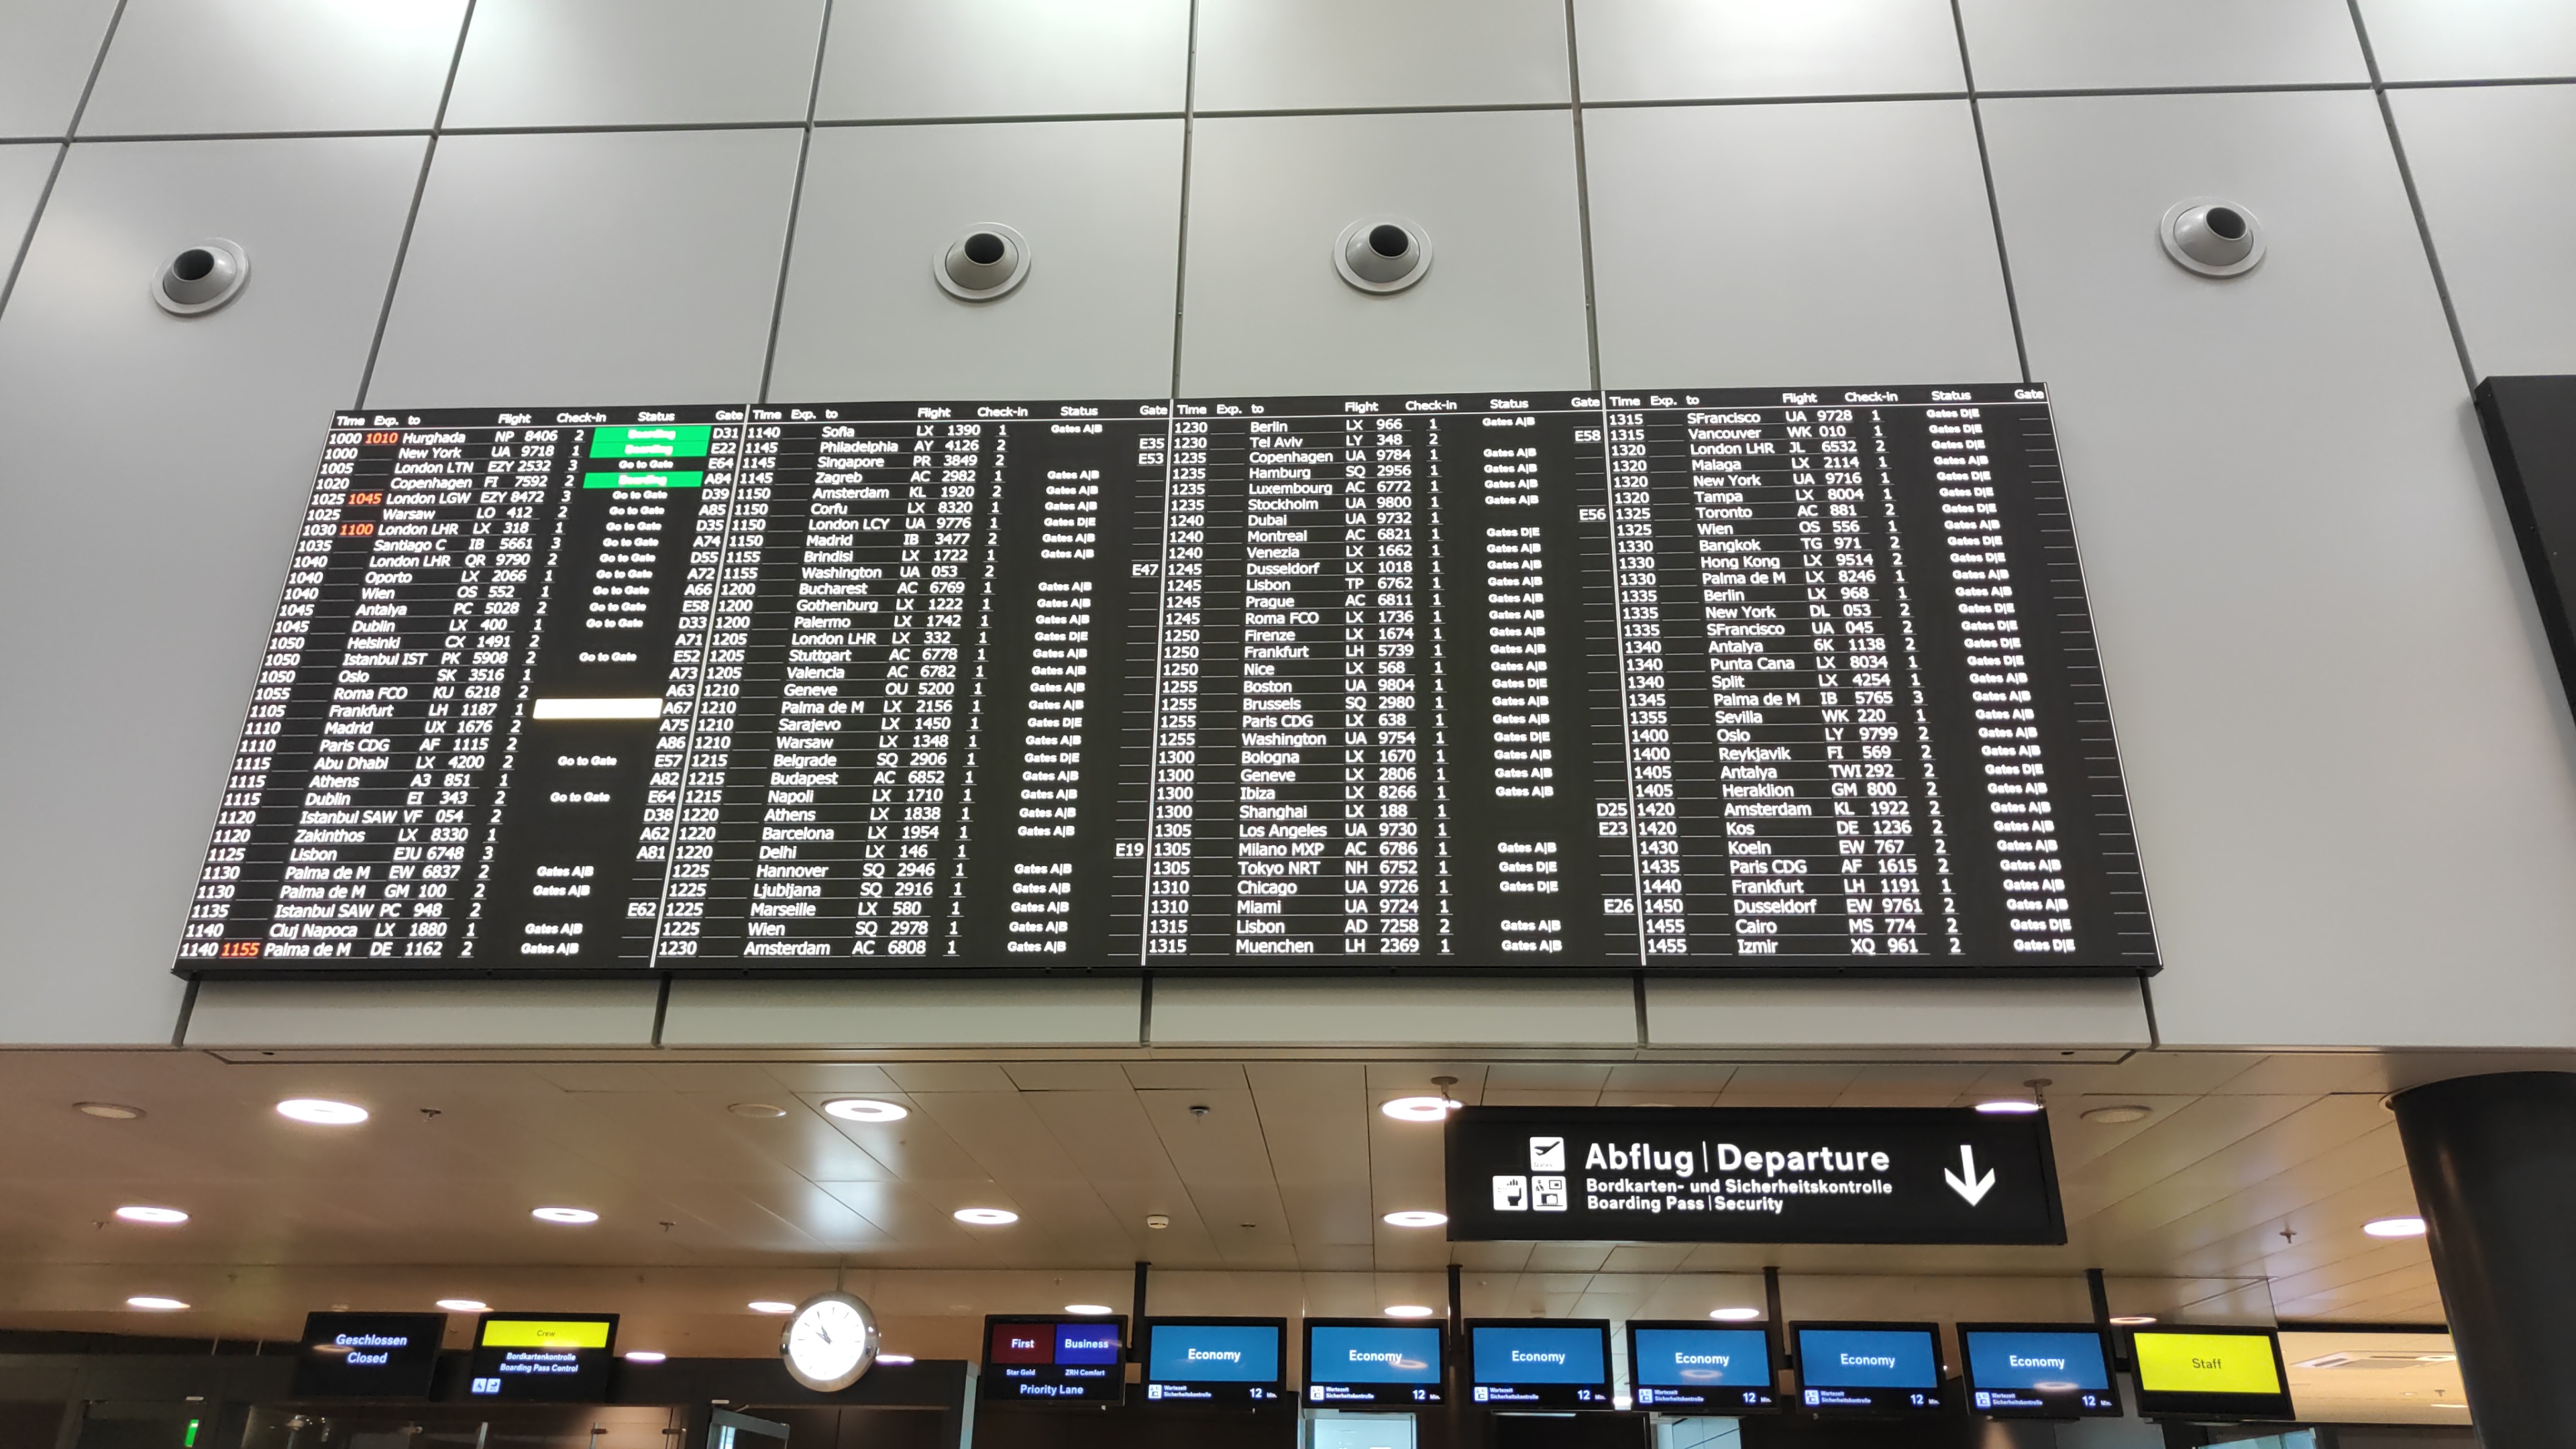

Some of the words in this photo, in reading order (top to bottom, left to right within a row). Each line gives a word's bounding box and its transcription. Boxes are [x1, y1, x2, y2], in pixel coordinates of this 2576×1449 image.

[1609, 396, 1640, 406] Time
[1651, 396, 1676, 407] Exp.
[1686, 396, 1699, 405] to
[1783, 393, 1817, 405] Flight
[1845, 392, 1898, 402] Check-in
[1932, 391, 1971, 400] Status
[2015, 390, 2044, 399] Gate
[1177, 405, 1206, 414] Time
[1217, 405, 1242, 415] Exp.
[1251, 405, 1264, 413] to
[1345, 402, 1378, 413] Flight
[1405, 400, 1456, 411] Check-in
[1491, 399, 1528, 409] Status
[1571, 397, 1601, 407] Gate
[337, 416, 365, 426] Time
[374, 416, 398, 427] Exp.
[409, 416, 420, 425] to
[498, 413, 531, 425] Flight
[557, 413, 606, 423] Check-in
[638, 412, 675, 421] Status
[715, 411, 743, 421] Gate
[753, 410, 782, 419] Time
[792, 409, 816, 421] Exp.
[826, 409, 838, 419] to
[918, 407, 951, 419] Flight
[977, 407, 1028, 417] Check-in
[1061, 407, 1097, 416] Status
[1140, 406, 1168, 415] Gate
[1610, 414, 1643, 425] 1315
[1688, 413, 1760, 424] SFrancisco
[1786, 411, 1807, 422] UA
[1817, 410, 1852, 421] 9728
[1872, 410, 1880, 421] 1
[1927, 409, 1958, 418] Gates
[329, 433, 362, 444] 1000
[366, 433, 398, 443] 1010
[402, 432, 466, 445] Hurghada
[495, 431, 515, 441] NP
[525, 430, 557, 441] 8406
[575, 430, 584, 441] 2
[713, 427, 738, 439] D31
[1175, 437, 1207, 449] 1230
[1250, 437, 1270, 447] Tel
[1274, 437, 1303, 447] Aviv
[1346, 435, 1362, 445] LY
[1377, 434, 1402, 445] 348
[1430, 433, 1438, 444] 2
[1575, 430, 1601, 441] E58
[745, 441, 778, 453] 1145
[820, 441, 898, 453] Philadelphia
[914, 441, 934, 451] AY
[945, 439, 979, 451] 4126
[997, 439, 1005, 450] 2
[1140, 438, 1165, 449] E35
[256, 688, 291, 700] 1055
[334, 688, 374, 700] Roma
[378, 687, 407, 699] FCO
[433, 686, 454, 698] KU
[465, 686, 500, 698] 6218
[519, 686, 528, 698] 2
[666, 684, 695, 696] A63
[1162, 698, 1196, 710] 1255
[1244, 698, 1301, 710] Brussels
[1346, 696, 1366, 711] SQ
[1379, 696, 1415, 708] 2980
[1436, 696, 1443, 708] 1
[1493, 696, 1525, 706] Gates
[1152, 900, 1188, 914] 1310
[1238, 900, 1281, 914] Miami
[1346, 900, 1368, 913] UA
[1380, 899, 1418, 913] 9724
[1440, 900, 1448, 913] 1
[1605, 899, 1633, 913] E26
[184, 943, 219, 957] 1140
[221, 943, 260, 956] 1155
[264, 943, 309, 957] Palma
[313, 943, 333, 956] de
[337, 943, 351, 956] M
[370, 942, 393, 956] DE
[405, 942, 442, 956] 1162
[462, 941, 472, 955] 2
[521, 943, 554, 953] Gates
[659, 941, 697, 955] 1230
[744, 941, 830, 955] Amsterdam
[852, 941, 875, 954] AC
[888, 941, 926, 954] 6808
[948, 941, 955, 954] 1
[1008, 942, 1041, 951] Gates
[1648, 939, 1686, 953] 1455
[1737, 939, 1778, 953] Izmir
[1851, 938, 1876, 955] XQ
[1888, 938, 1918, 953] 961
[1950, 938, 1961, 953] 2
[2014, 939, 2050, 951] Gates
[1585, 1143, 1693, 1175] Abflug
[1718, 1144, 1889, 1177] Departure
[1587, 1178, 1684, 1192] Bordkarten-
[1690, 1179, 1720, 1193] und
[1725, 1179, 1892, 1193] Sicherheitskontrolle
[1588, 1195, 1661, 1213] Boarding
[1666, 1196, 1704, 1210] Pass
[1715, 1196, 1783, 1214] Security
[335, 1334, 407, 1346] Geschlossen
[1012, 1339, 1034, 1348] First
[1065, 1339, 1109, 1348] Business
[346, 1351, 388, 1363] Closed
[506, 1352, 576, 1360] Bordkartenkontrolle
[1189, 1348, 1240, 1362] Economy
[1350, 1350, 1403, 1364] Economy
[1512, 1351, 1565, 1364] Economy
[1676, 1352, 1729, 1366] Economy
[1841, 1354, 1894, 1368] Economy
[500, 1363, 532, 1373] Boarding
[533, 1363, 550, 1372] Pass
[551, 1364, 579, 1373] Control
[2010, 1356, 2064, 1369] Economy
[2192, 1358, 2220, 1368] Staff
[1020, 1385, 1057, 1396] Priority
[1060, 1385, 1083, 1394] Lane
[1250, 1388, 1262, 1397] 12
[1413, 1390, 1425, 1399] 12
[1578, 1390, 1590, 1400] 12
[1743, 1393, 1756, 1402] 12
[1911, 1395, 1923, 1404] 12
[2082, 1396, 2096, 1405] 12
